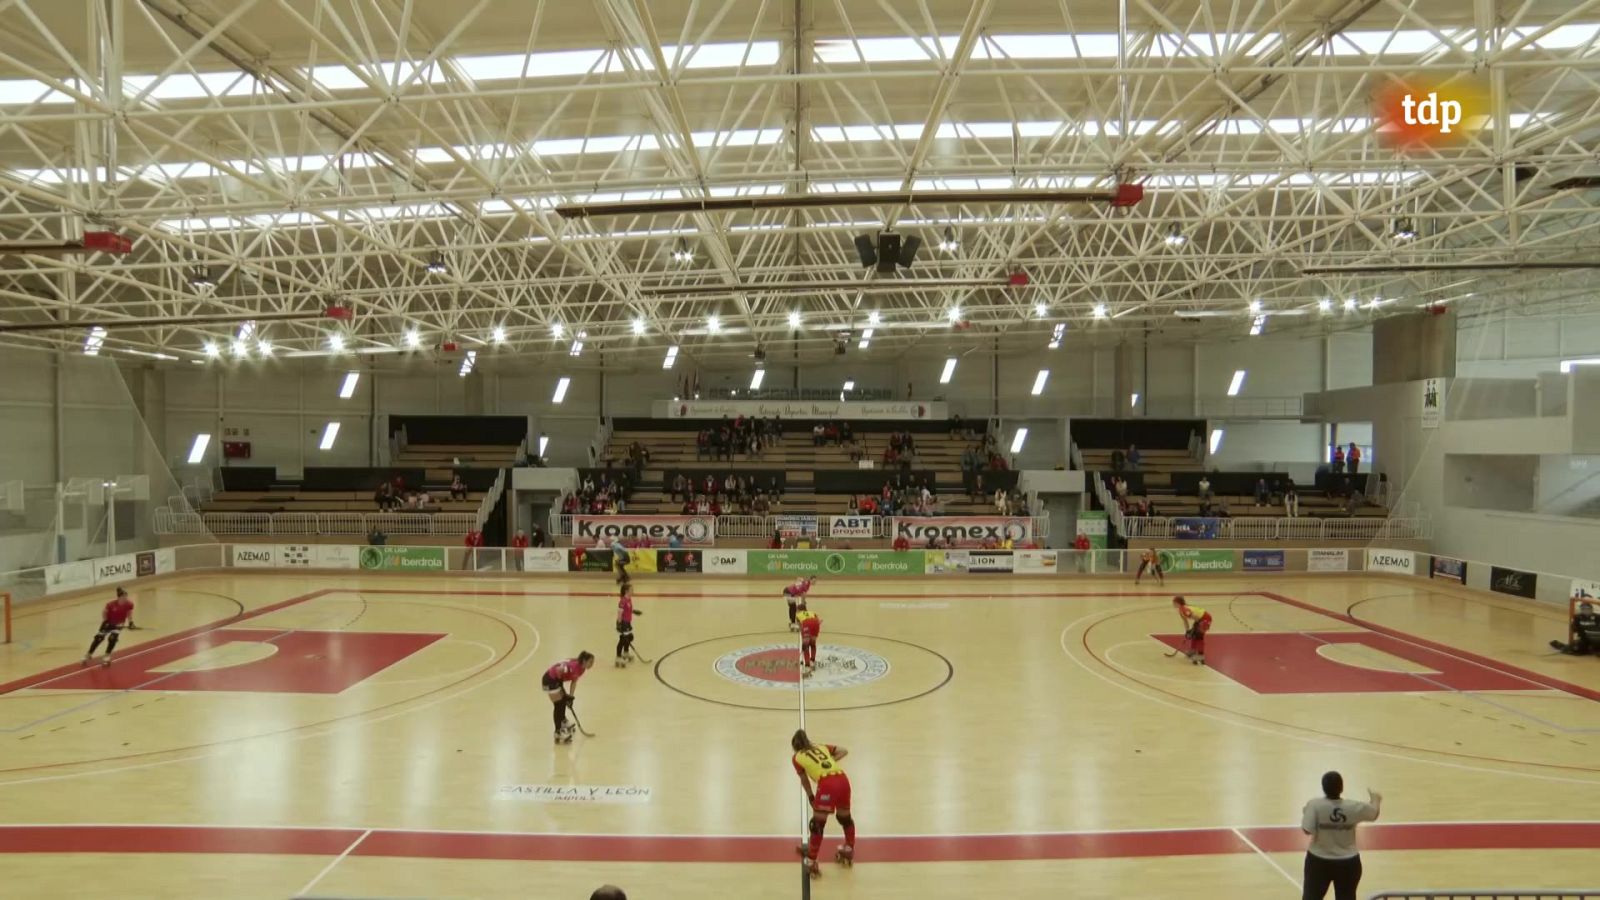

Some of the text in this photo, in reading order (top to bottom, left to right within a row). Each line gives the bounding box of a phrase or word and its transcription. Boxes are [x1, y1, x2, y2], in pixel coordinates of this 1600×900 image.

[578, 520, 681, 538] Kromex
[834, 518, 871, 528] ABT
[898, 522, 999, 540] Kromex
[237, 551, 270, 562] AZEMAD
[720, 557, 737, 565] DAP
[1373, 556, 1410, 568] AZEMAD
[100, 562, 132, 577] AZEMAD
[805, 747, 828, 764] 19
[589, 787, 600, 797] Y
[604, 785, 650, 797] LEÓN
